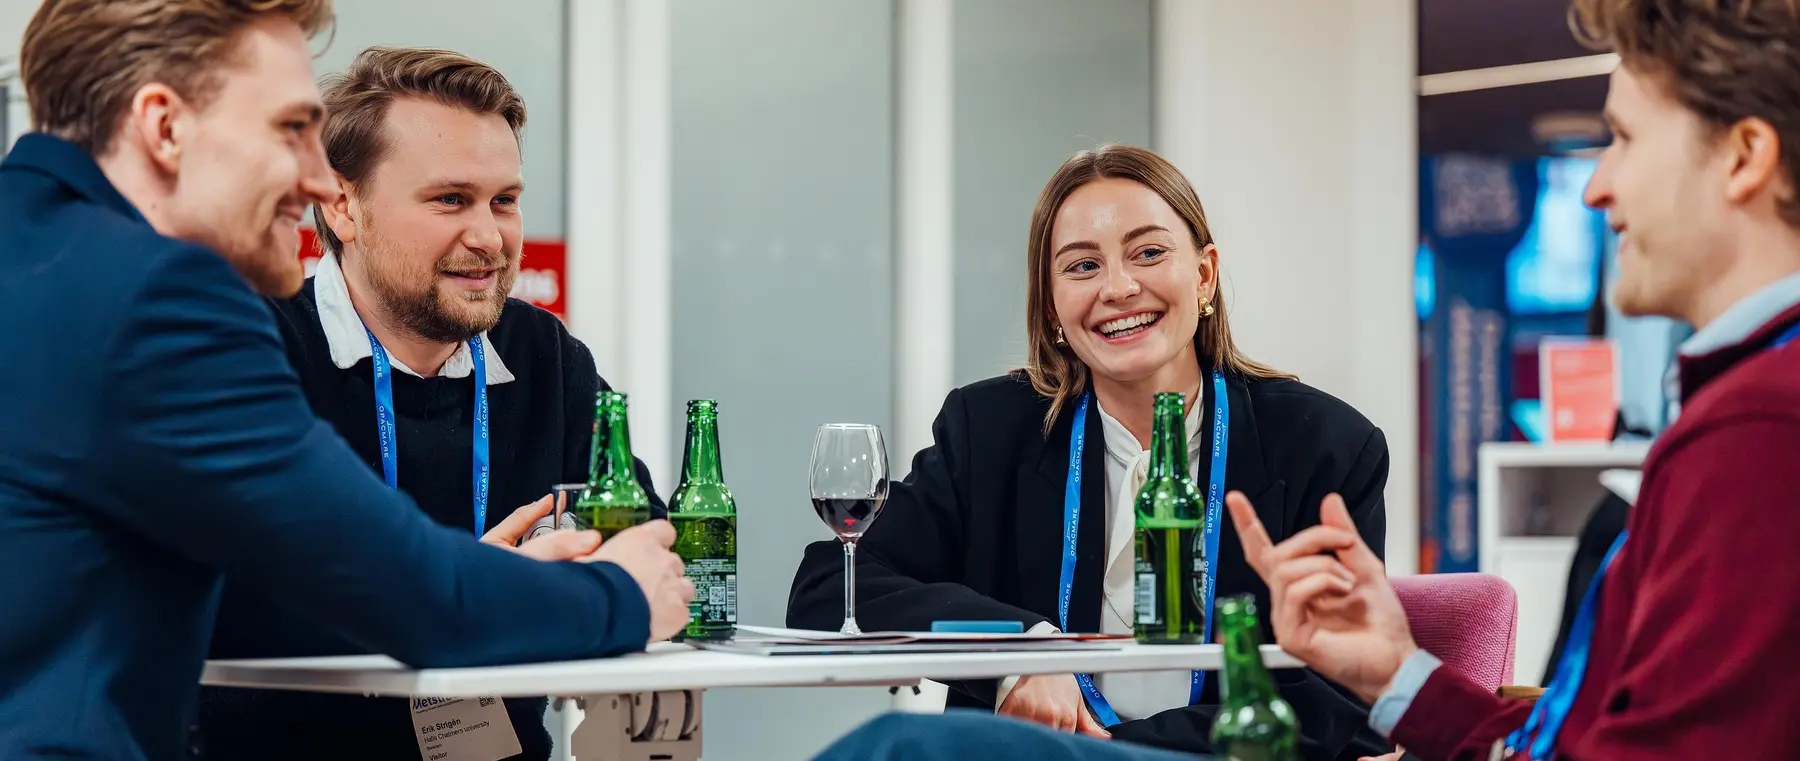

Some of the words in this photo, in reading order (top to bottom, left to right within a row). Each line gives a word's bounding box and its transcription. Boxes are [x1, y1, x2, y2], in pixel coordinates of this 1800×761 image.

[378, 405, 388, 458] OPACMARE
[1214, 407, 1222, 458] OPACMARE
[1074, 434, 1082, 482] OPACMARE
[1070, 508, 1078, 556] OPACMARE
[1206, 483, 1217, 534] OPACMARE
[422, 726, 435, 734] Erik
[463, 721, 490, 732] university
[428, 752, 448, 760] Visitor
